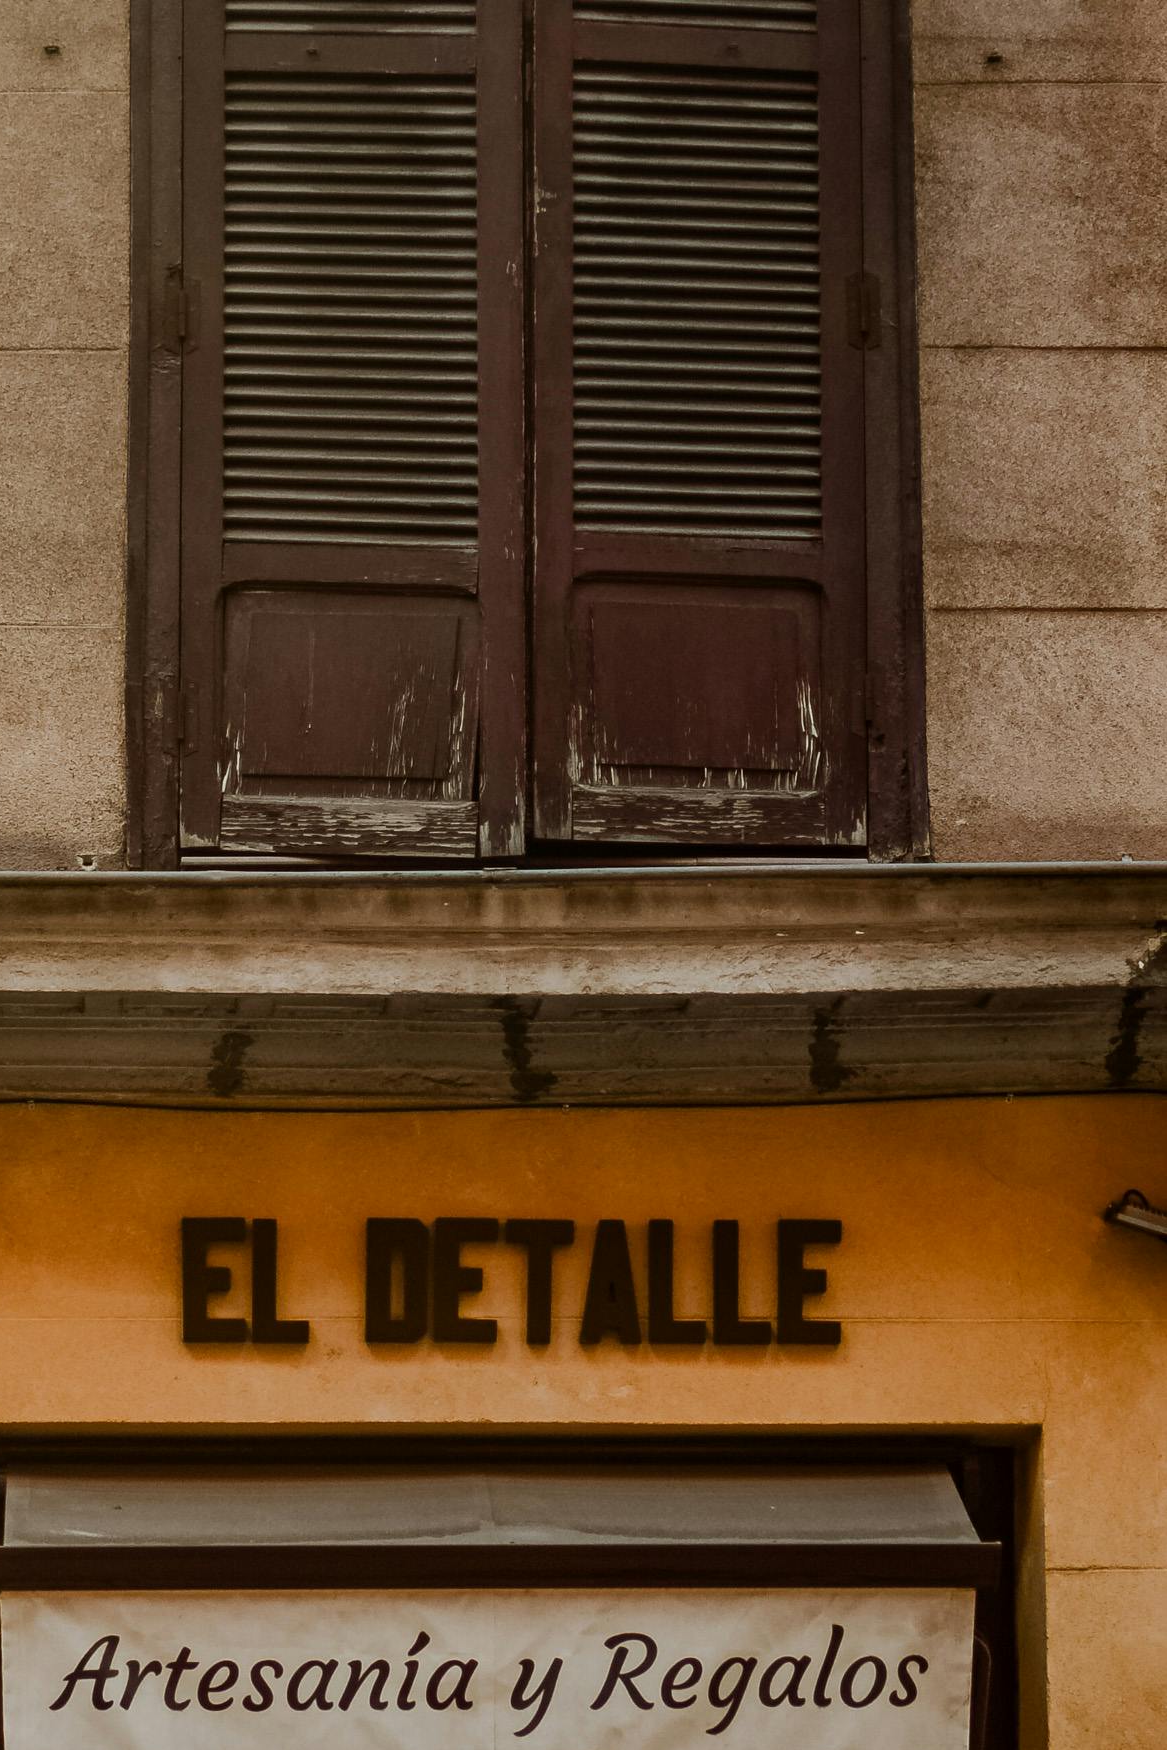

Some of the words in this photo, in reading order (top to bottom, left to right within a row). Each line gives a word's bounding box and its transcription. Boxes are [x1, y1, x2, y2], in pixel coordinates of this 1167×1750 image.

[181, 1217, 309, 1343] EL
[365, 1217, 842, 1345] DETALLE
[49, 1630, 479, 1712] Artesanía
[509, 1657, 563, 1738] y
[589, 1624, 930, 1735] Regalos
